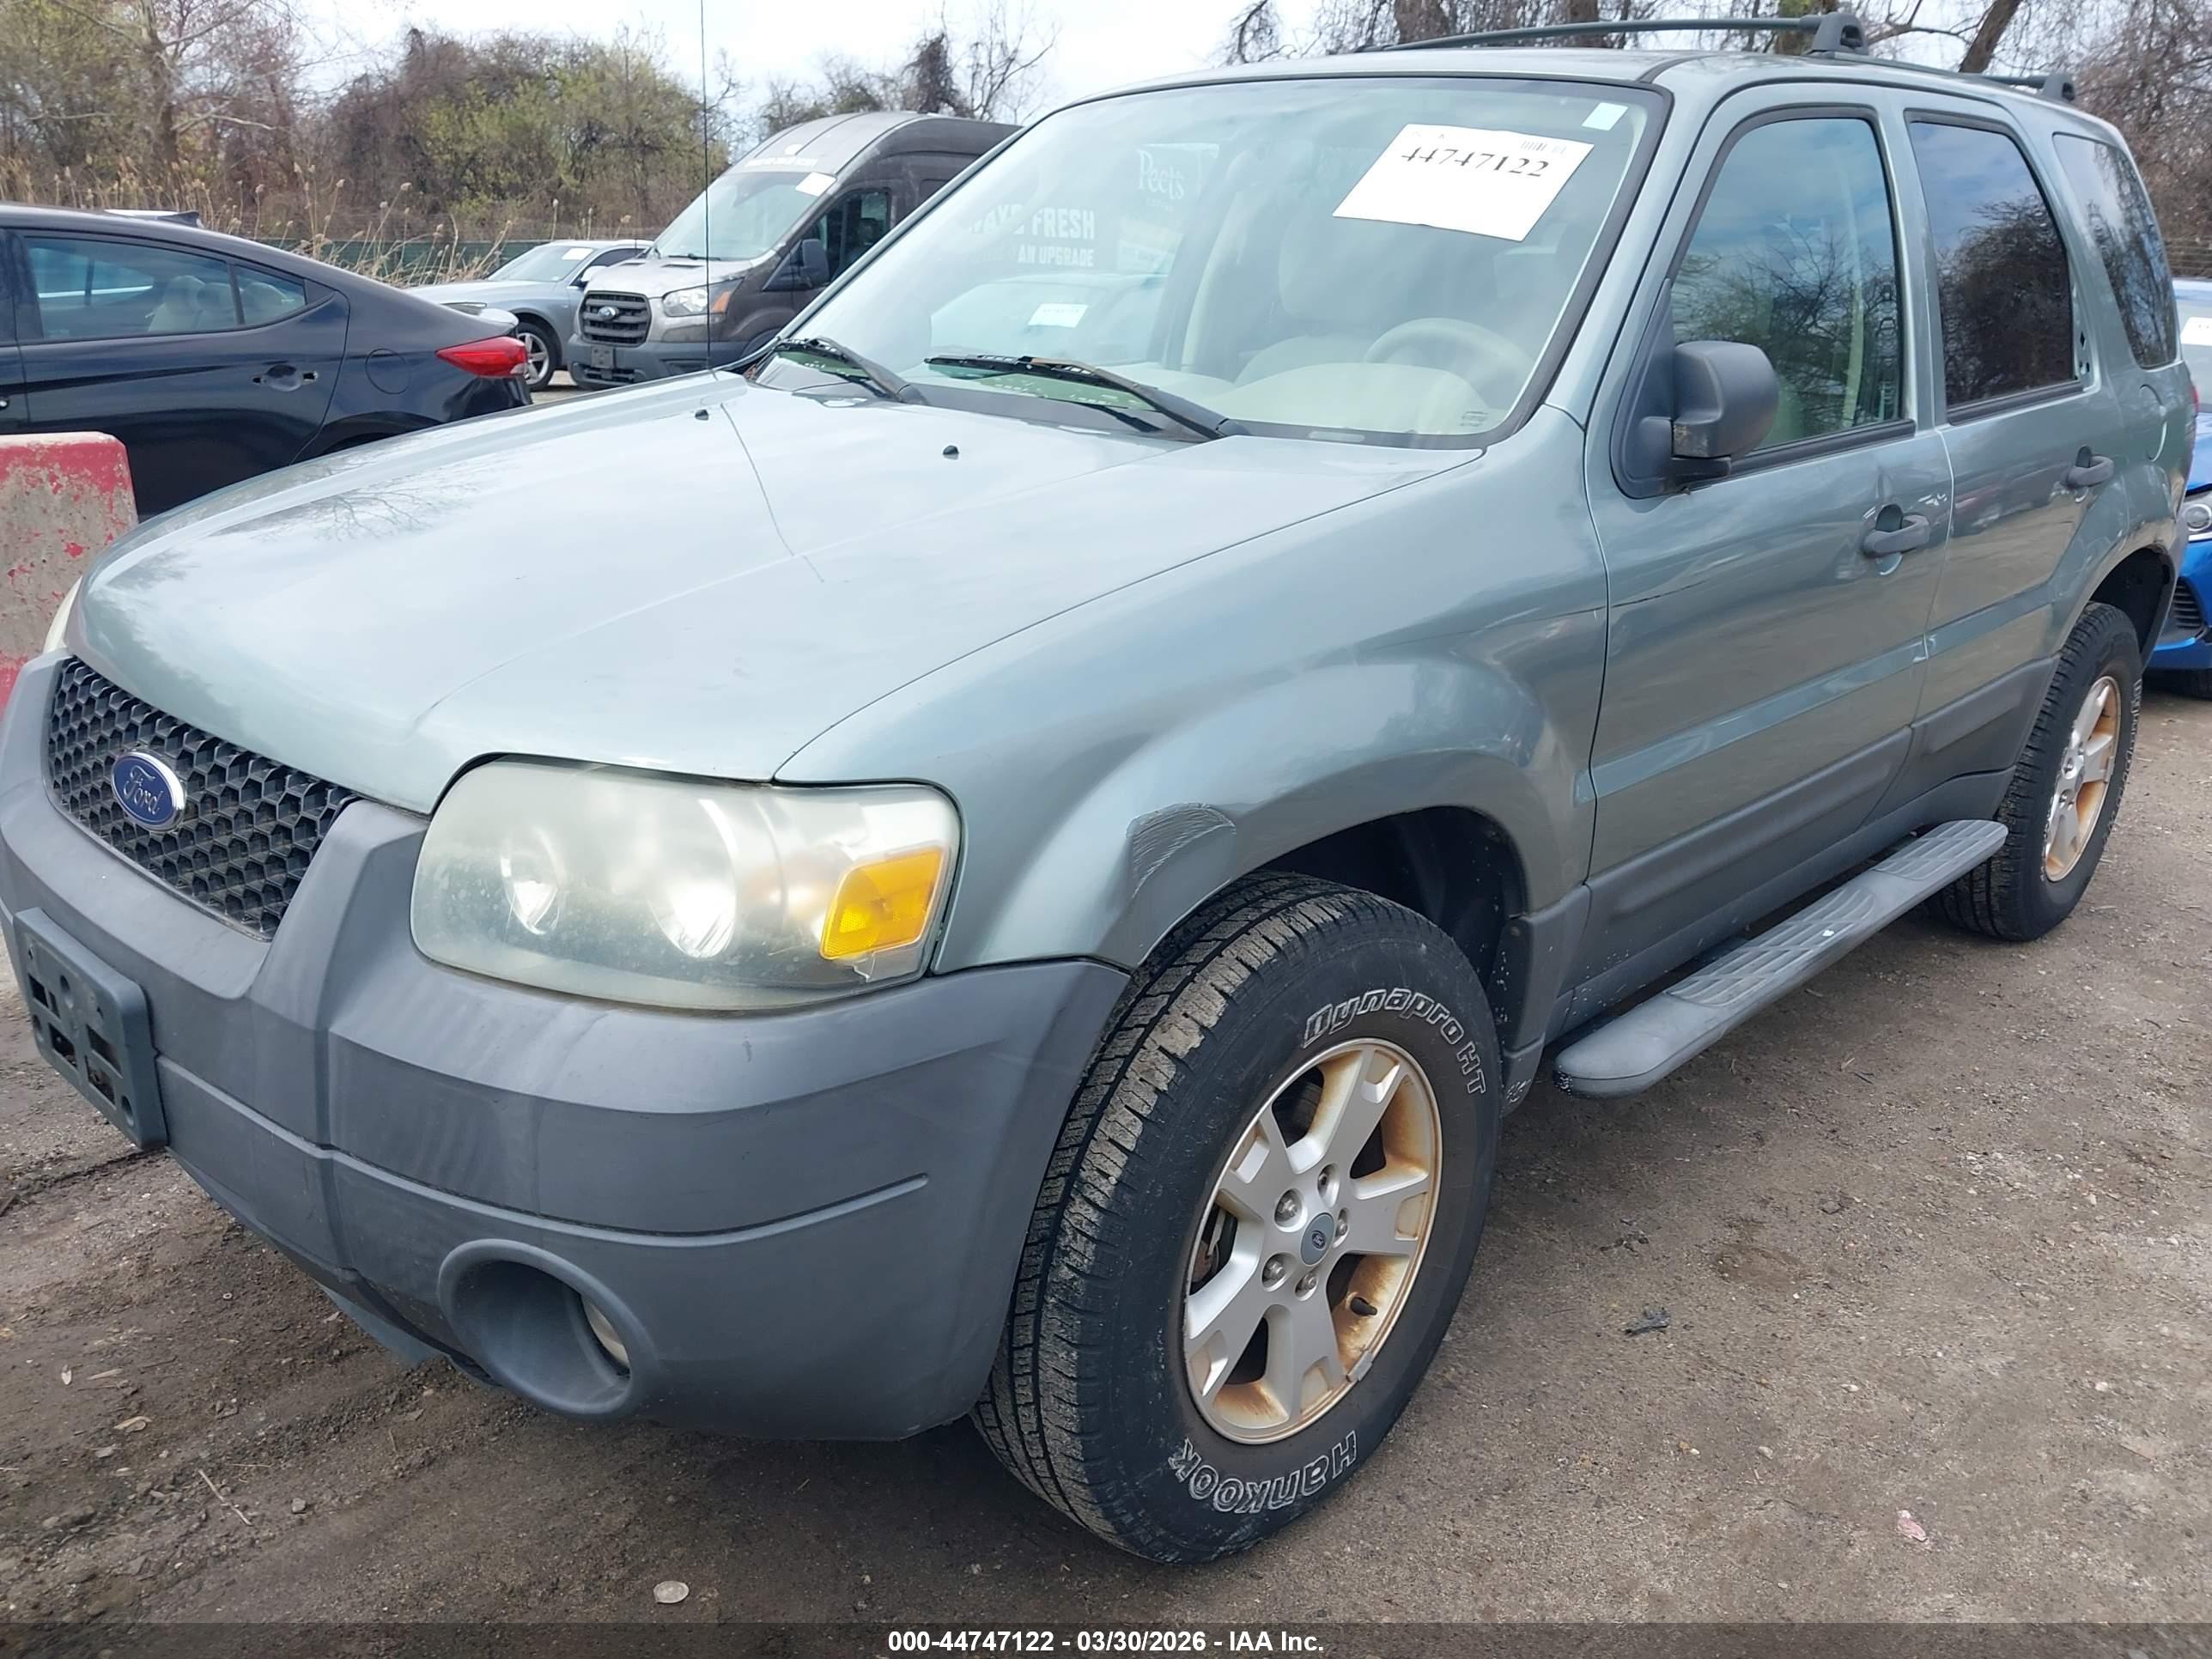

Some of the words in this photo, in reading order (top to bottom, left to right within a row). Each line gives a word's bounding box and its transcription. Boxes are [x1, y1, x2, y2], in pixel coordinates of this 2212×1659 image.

[1401, 146, 1549, 178] 44747122
[1032, 207, 1095, 240] FRESH
[1018, 244, 1036, 264] AN
[1039, 246, 1095, 267] UPGRADE
[124, 765, 164, 815] Ford
[1303, 988, 1464, 1048] Dynapro
[1457, 1041, 1486, 1094] HT
